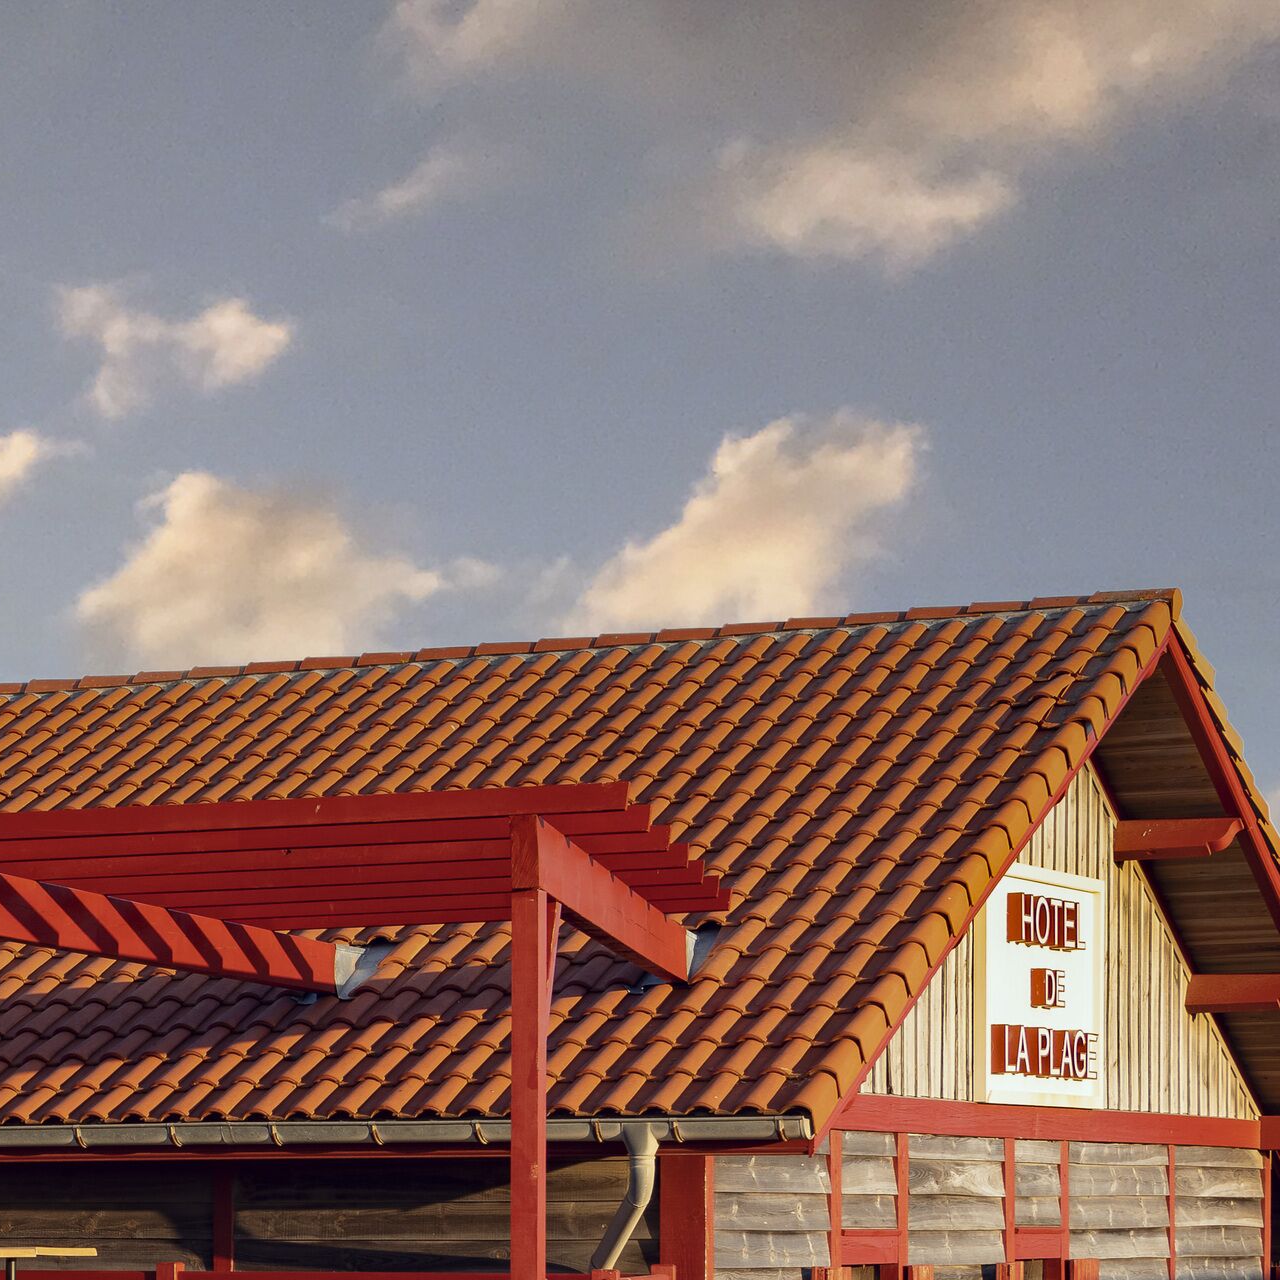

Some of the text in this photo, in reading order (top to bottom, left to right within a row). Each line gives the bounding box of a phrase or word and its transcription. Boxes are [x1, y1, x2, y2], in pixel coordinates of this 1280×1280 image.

[1011, 892, 1087, 952] HOTEL
[1034, 968, 1066, 1009] DE
[995, 1024, 1099, 1080] LA PLAGE
